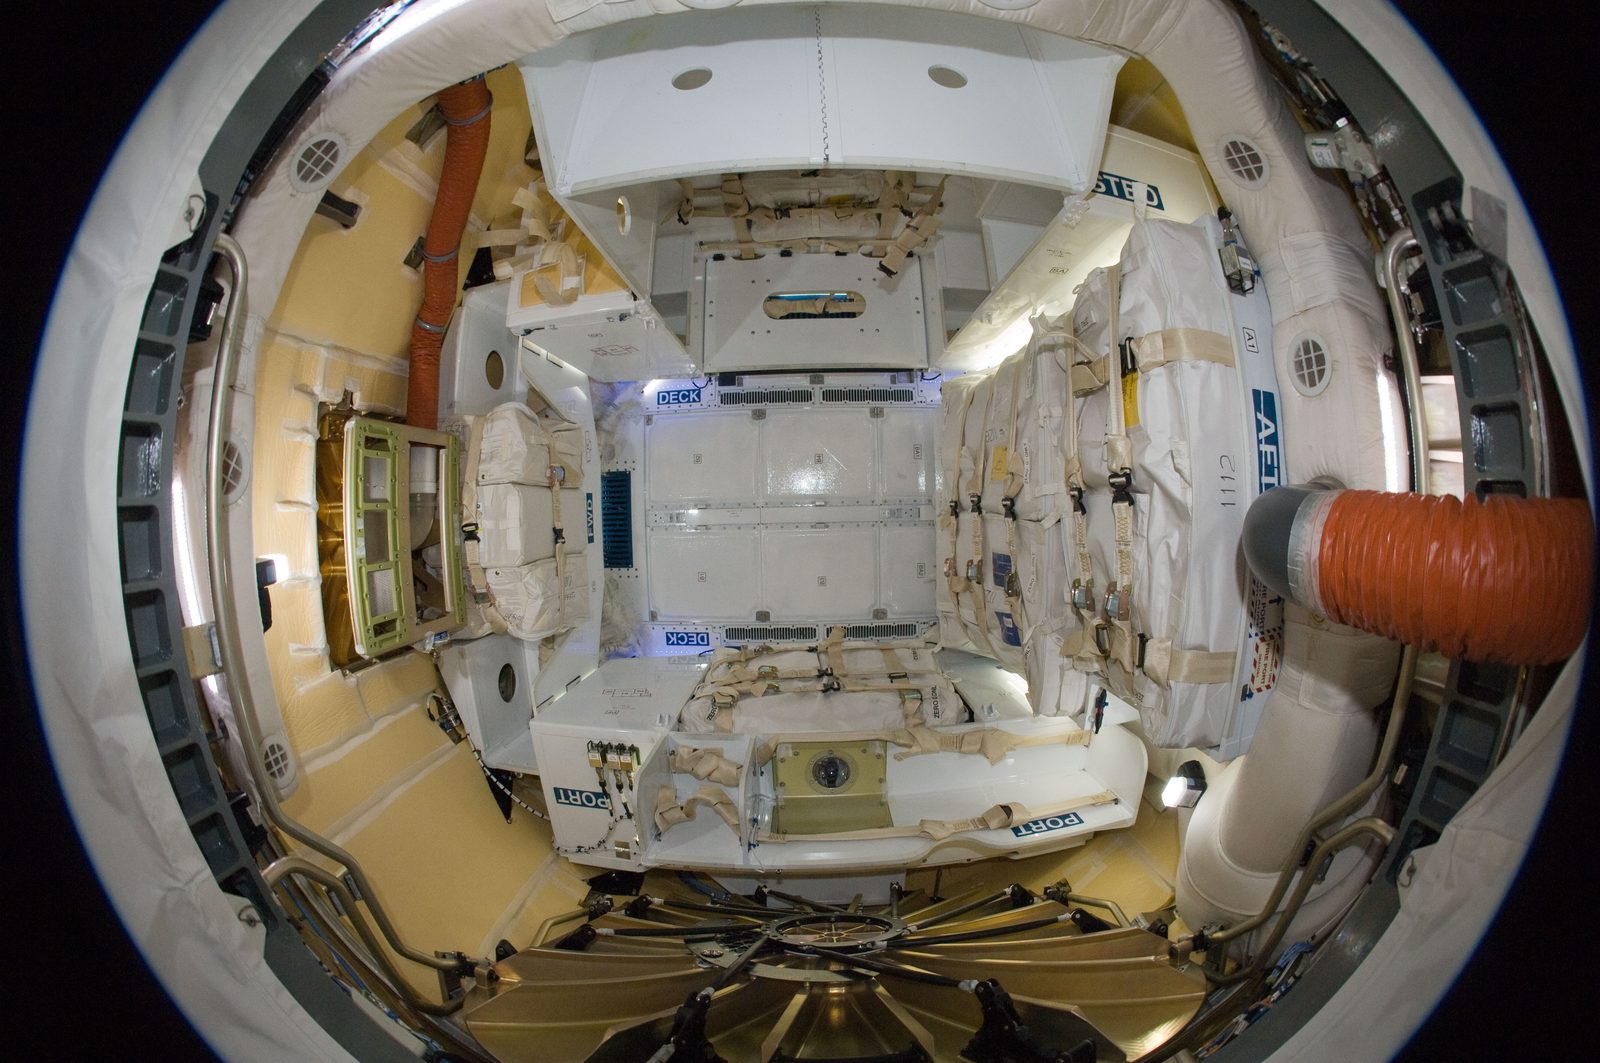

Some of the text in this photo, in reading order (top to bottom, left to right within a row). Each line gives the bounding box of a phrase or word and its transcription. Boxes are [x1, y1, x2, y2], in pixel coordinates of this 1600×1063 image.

[1245, 330, 1256, 349] A1
[659, 390, 700, 404] DECK
[1257, 410, 1278, 487] AFT
[1220, 454, 1236, 507] 1112
[666, 632, 708, 645] DECK
[932, 700, 940, 719] ZERO
[557, 789, 612, 810] PORT
[1017, 813, 1080, 836] PORT
